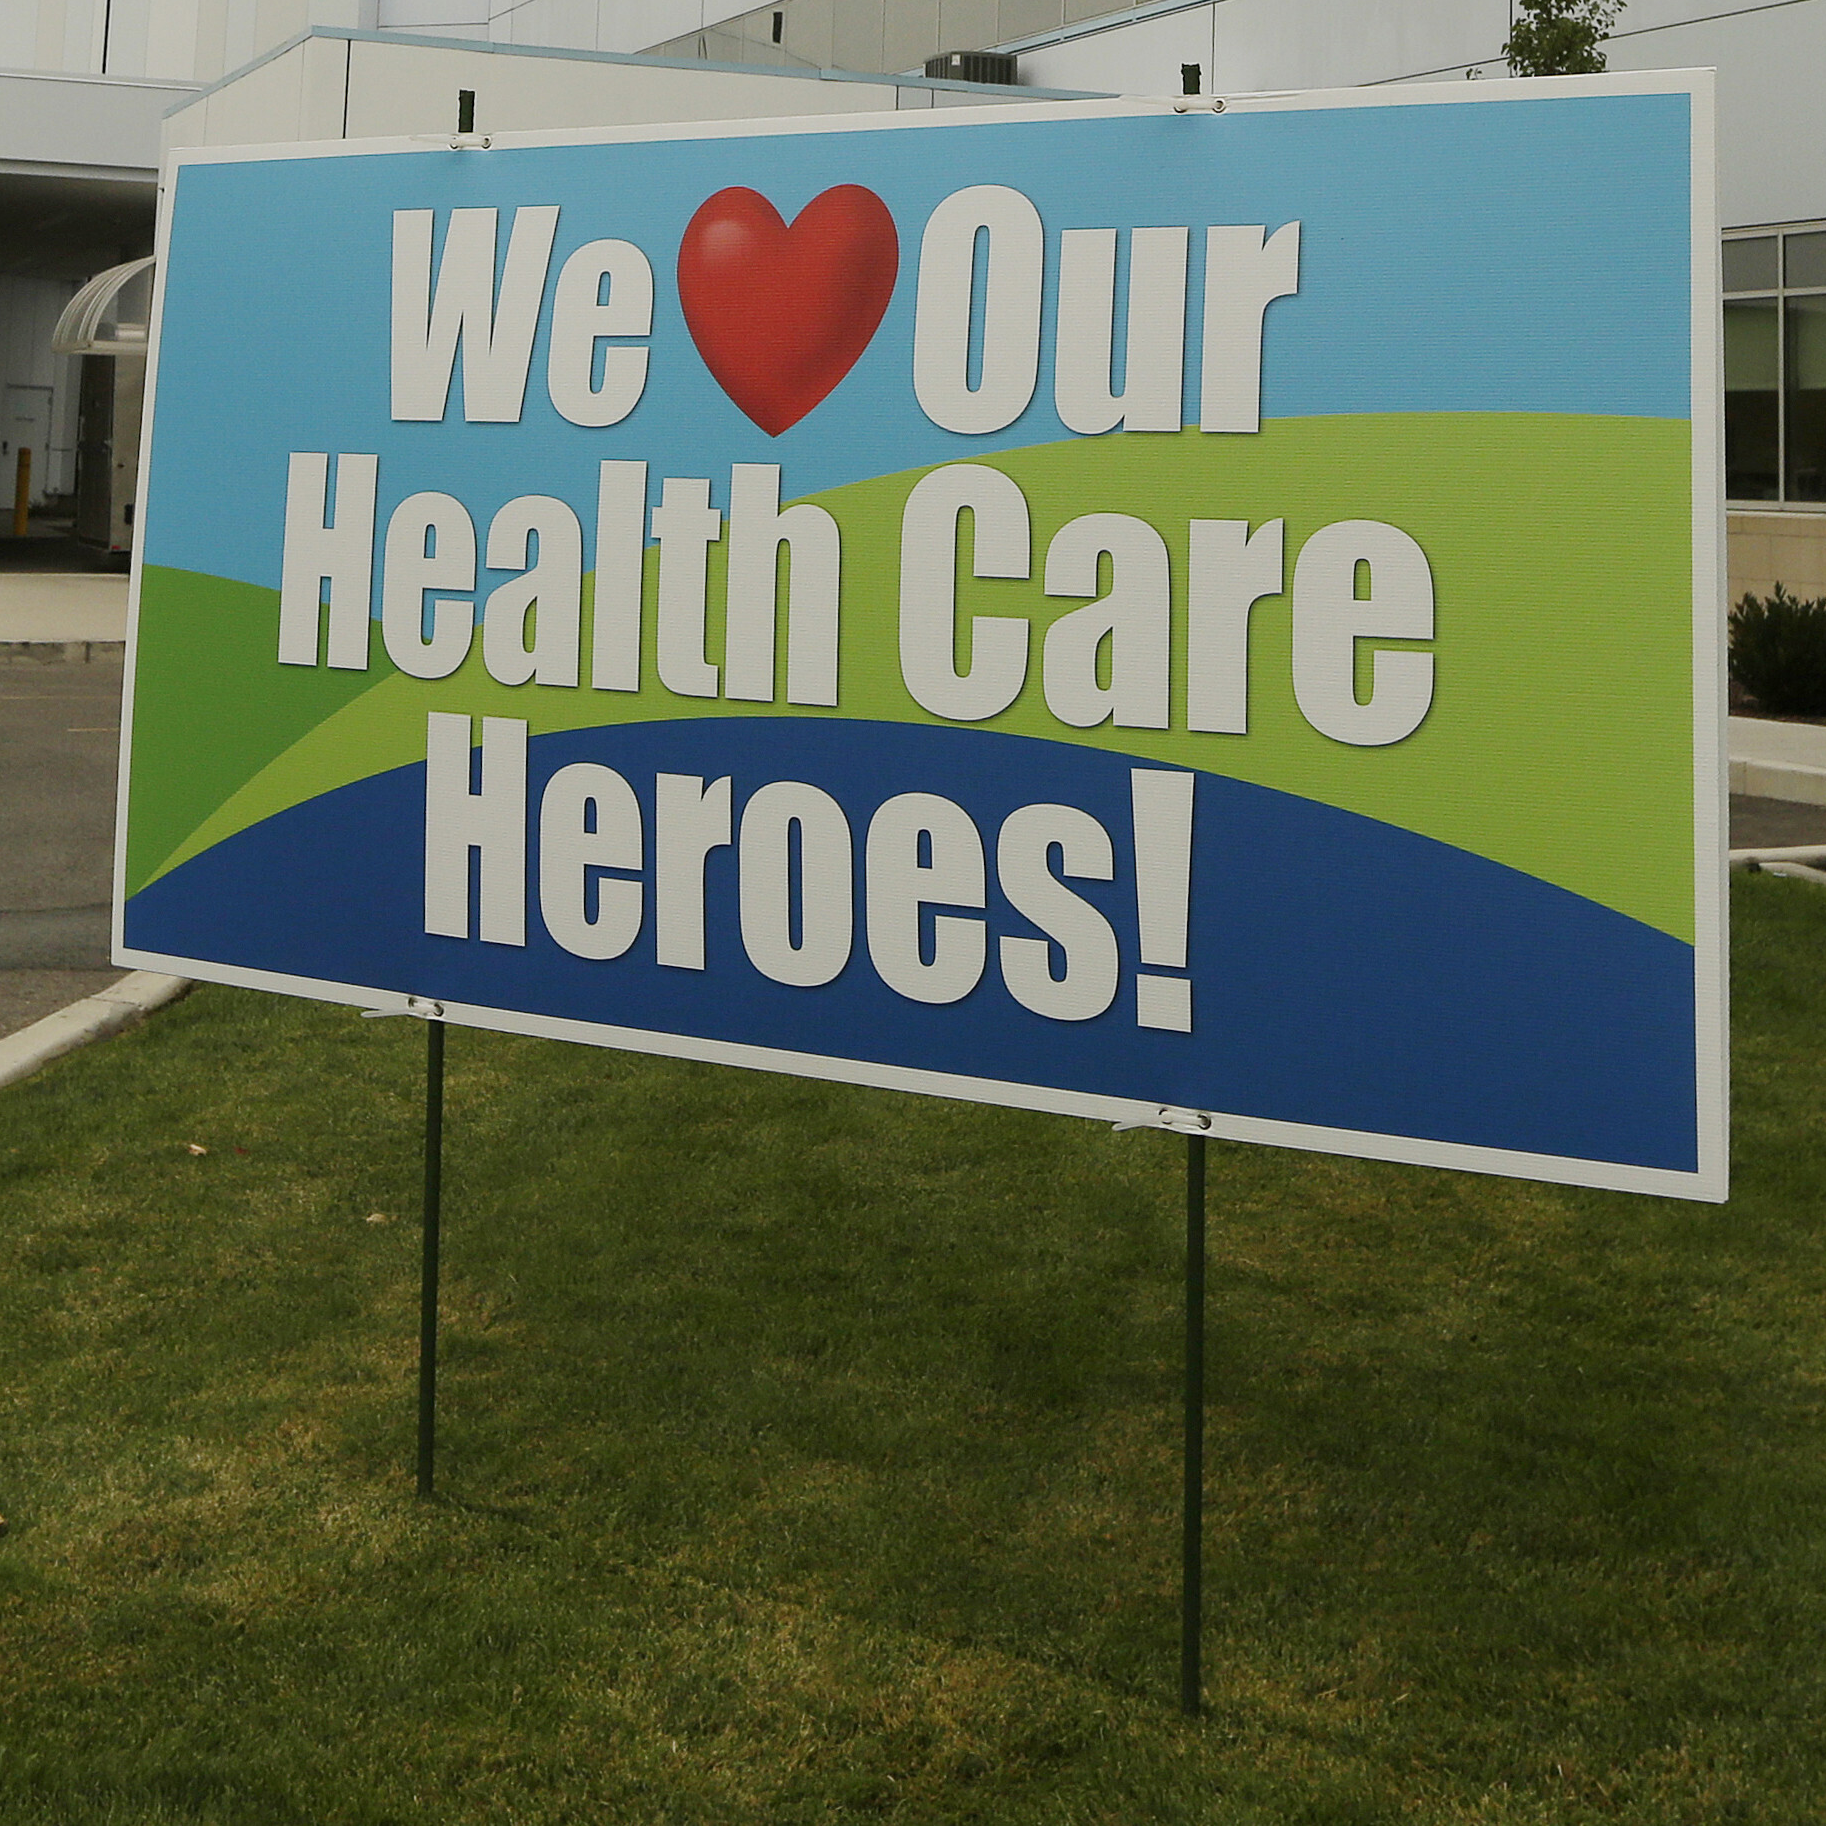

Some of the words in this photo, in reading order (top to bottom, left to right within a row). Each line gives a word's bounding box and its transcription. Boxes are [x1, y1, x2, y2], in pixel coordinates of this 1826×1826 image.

[390, 205, 655, 428] We
[913, 184, 1301, 436] Our
[277, 452, 841, 708] Health
[898, 463, 1435, 748] Care
[424, 711, 1195, 1034] Heroes!
